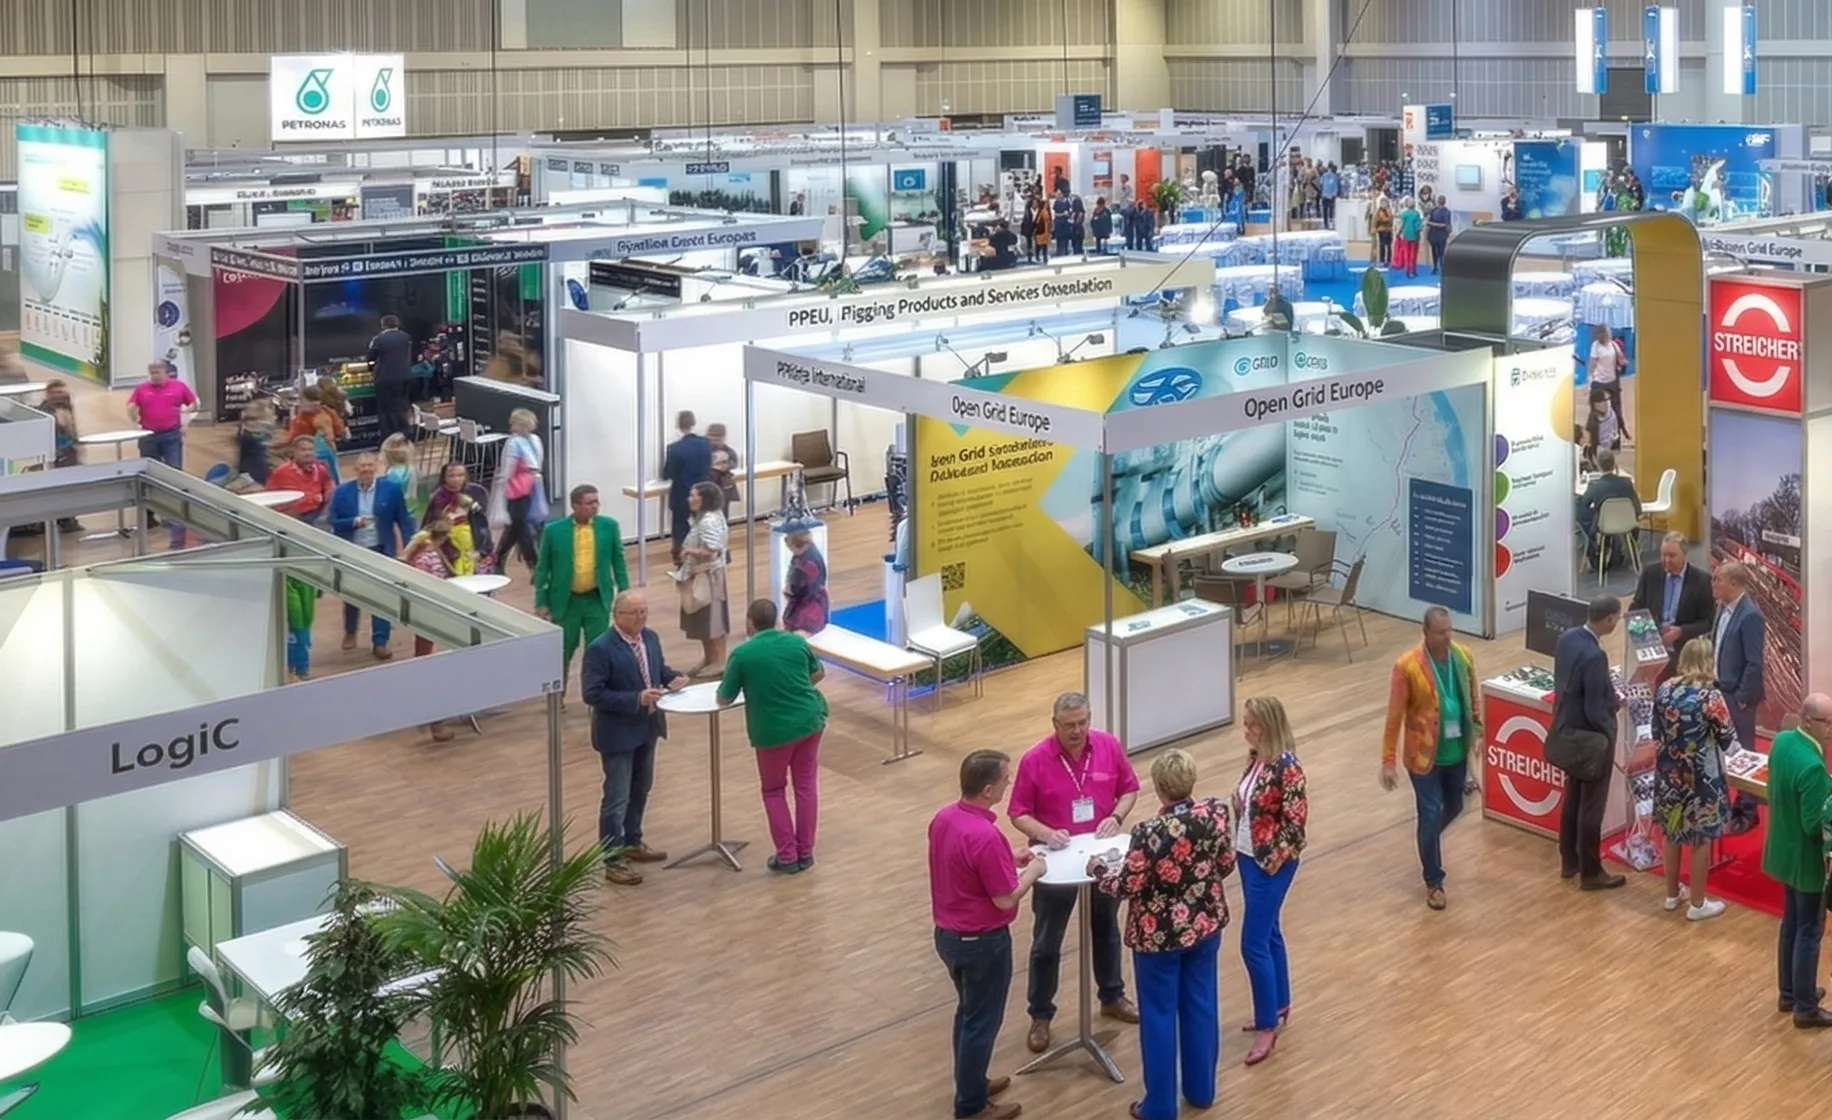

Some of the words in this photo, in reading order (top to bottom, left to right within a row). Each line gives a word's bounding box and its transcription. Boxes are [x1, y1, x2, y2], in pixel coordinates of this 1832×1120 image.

[282, 119, 346, 130] PETRONAS
[899, 295, 958, 314] Products
[961, 289, 985, 306] and
[987, 285, 1040, 304] Services
[1714, 332, 1799, 360] STREICHER
[952, 395, 980, 418] Open
[983, 401, 1007, 422] Grid
[1010, 406, 1051, 433] Europe
[1244, 394, 1288, 420] Open
[1292, 384, 1326, 408] Grid
[1330, 379, 1385, 401] Europe
[959, 446, 986, 462] Grid
[112, 718, 240, 774] LogiC
